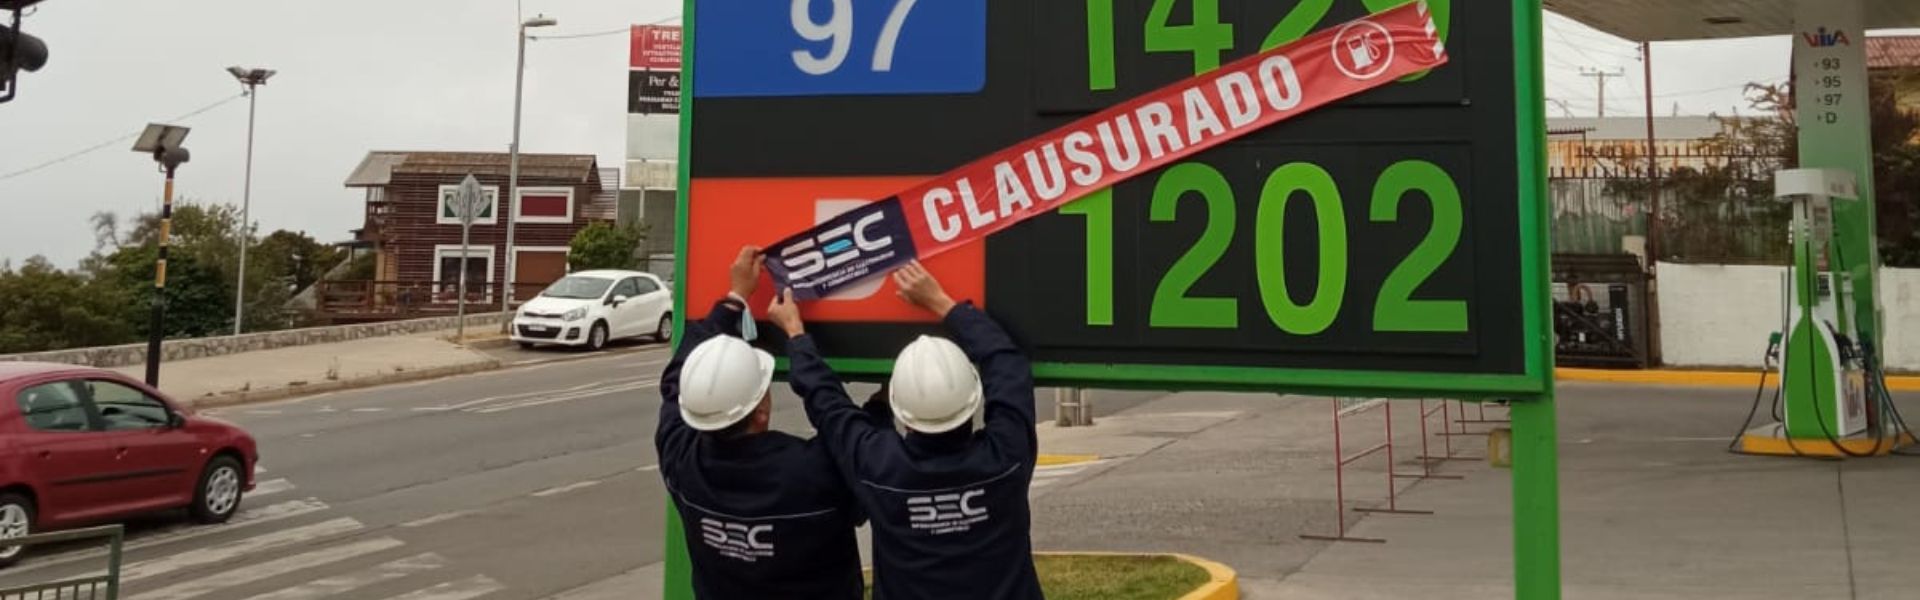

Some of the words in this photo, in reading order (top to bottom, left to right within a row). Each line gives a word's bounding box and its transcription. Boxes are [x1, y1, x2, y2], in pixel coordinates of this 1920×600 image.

[791, 0, 916, 75] 97
[1087, 0, 1450, 90] 14
[1821, 58, 1840, 71] 93
[1823, 75, 1842, 88] 95
[1824, 93, 1843, 106] 97
[922, 55, 1302, 243] CLAUSURADO
[781, 210, 893, 281] SEC
[1058, 159, 1468, 336] 1202
[906, 488, 987, 522] SEC
[700, 518, 775, 550] SEC
